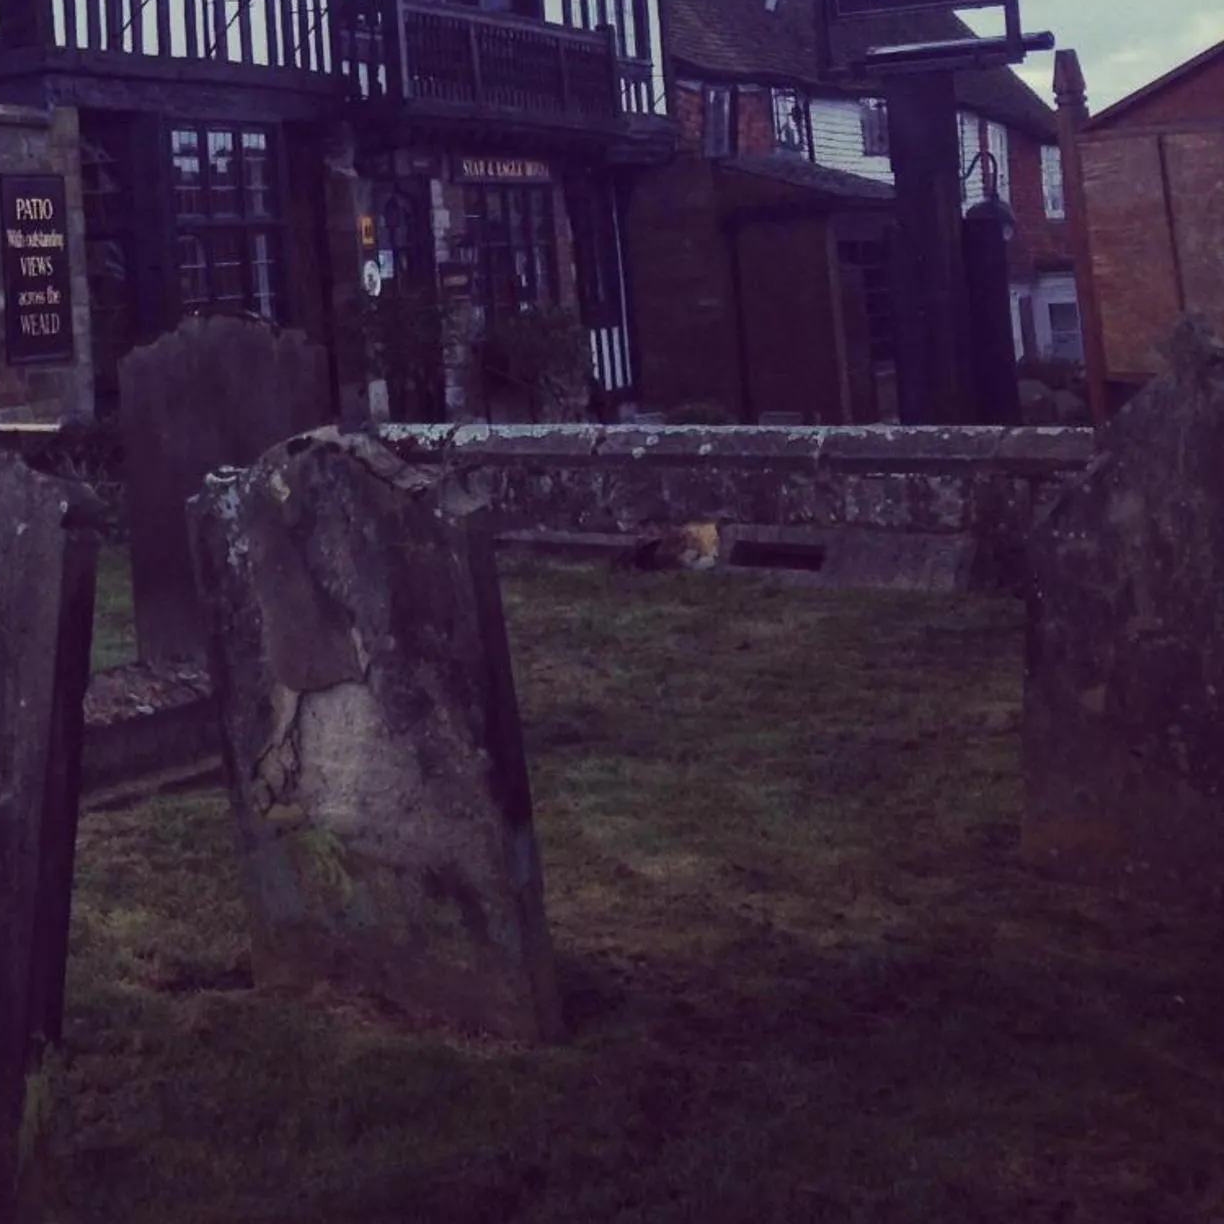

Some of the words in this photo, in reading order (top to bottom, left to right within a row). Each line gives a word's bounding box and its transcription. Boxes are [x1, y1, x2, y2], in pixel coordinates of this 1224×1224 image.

[16, 197, 53, 221] PATIO
[20, 255, 54, 277] VIEWS
[20, 312, 60, 336] WEALD
